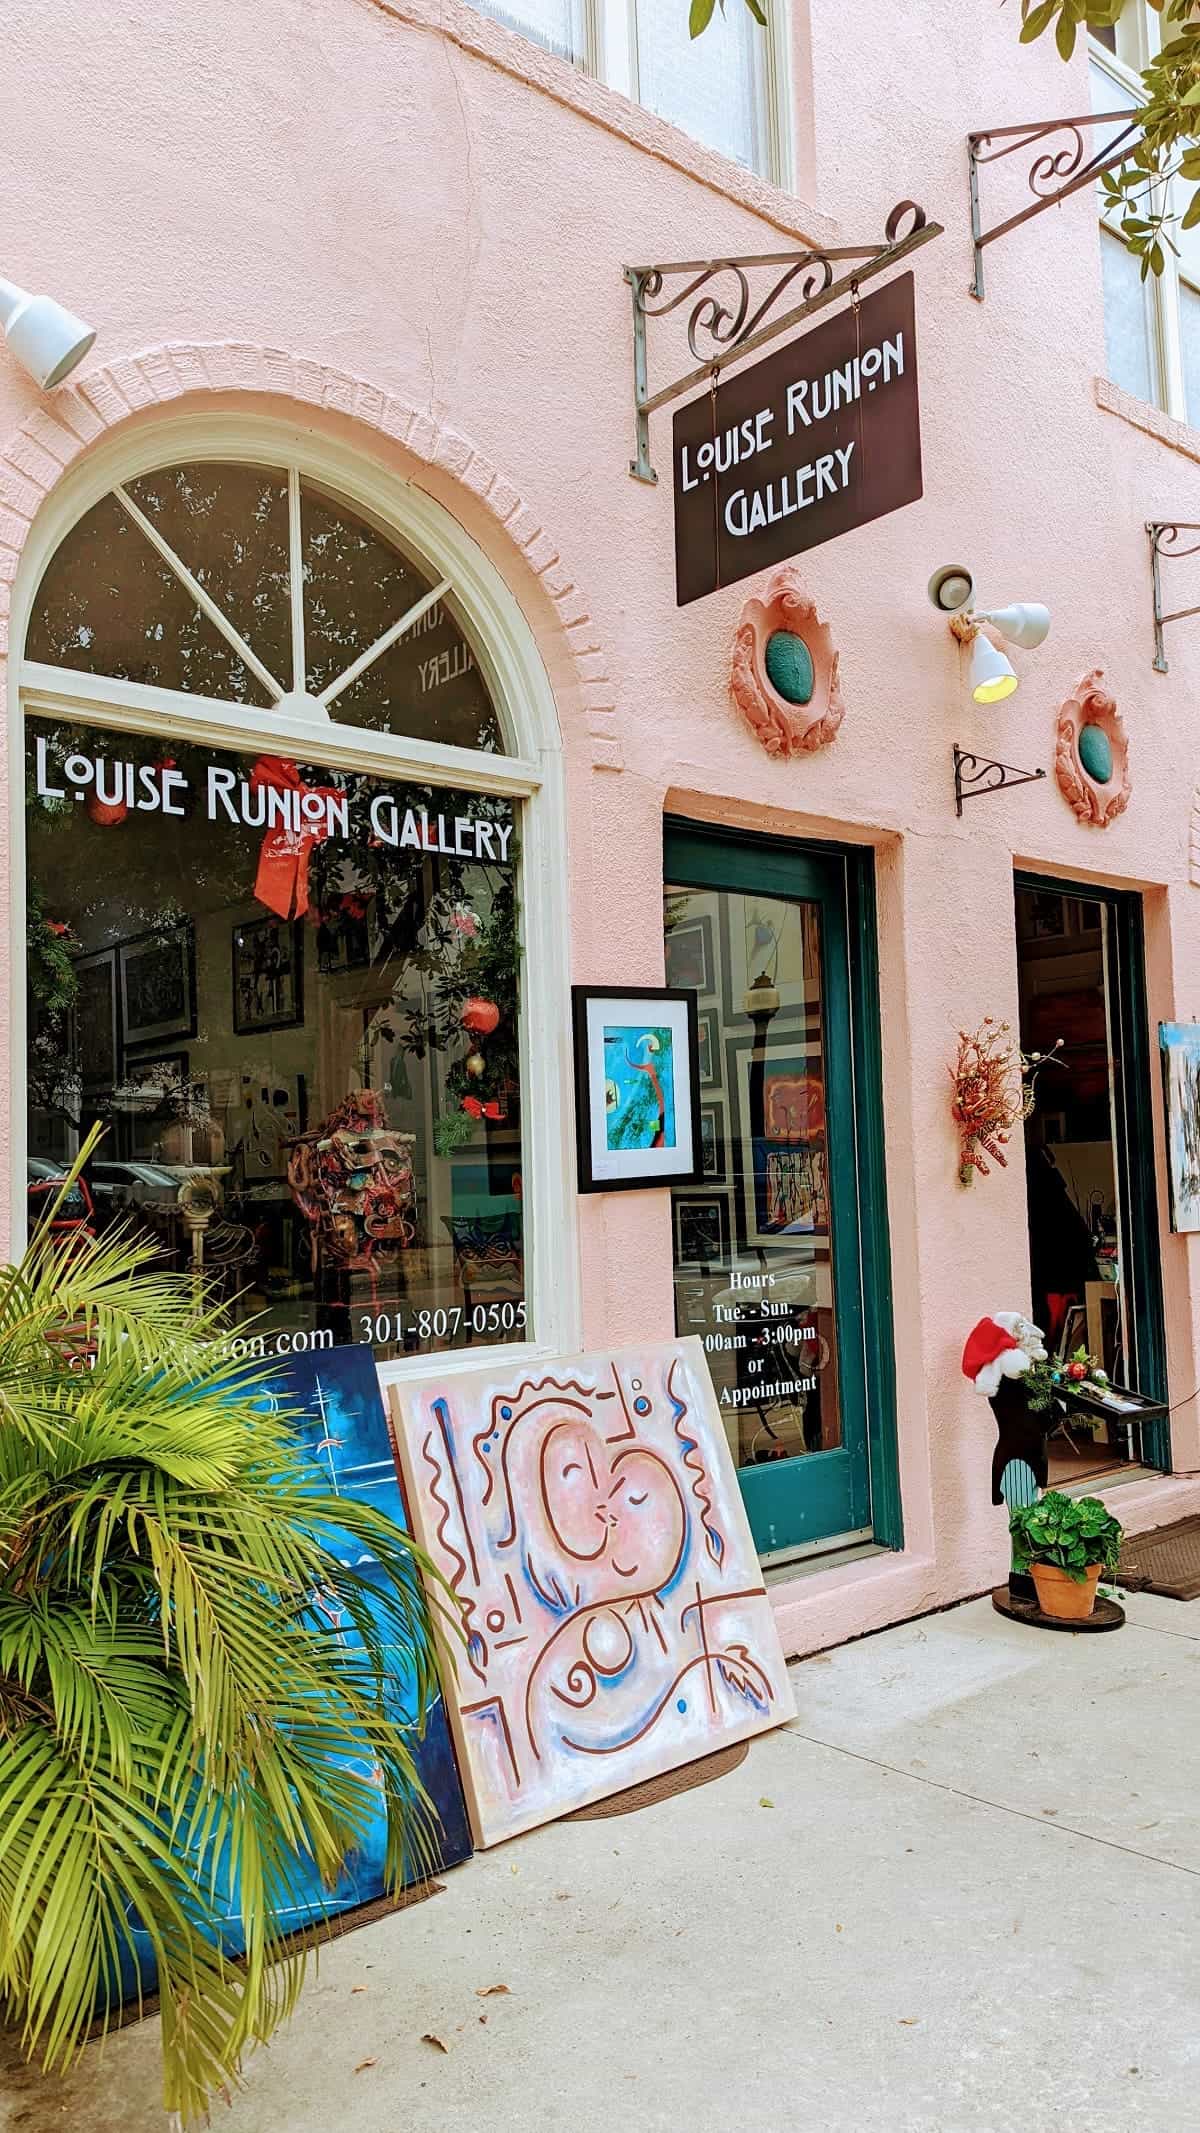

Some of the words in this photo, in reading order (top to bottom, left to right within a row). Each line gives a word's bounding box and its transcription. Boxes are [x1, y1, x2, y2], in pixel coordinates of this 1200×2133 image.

[682, 408, 774, 492] LOUISE
[787, 332, 904, 435] RUNION
[725, 441, 855, 536] GALLERY
[36, 737, 189, 815] LOUISE
[207, 766, 349, 839] RUNION
[370, 795, 513, 862] GALLERY
[729, 1272, 776, 1289] Hours
[359, 1301, 528, 1344] 301-807-0505
[712, 1304, 746, 1323] Tue.
[760, 1300, 793, 1317] Sun.
[761, 1325, 816, 1346] 3:00pm
[748, 1359, 764, 1373] or
[719, 1373, 817, 1408] Appointment
